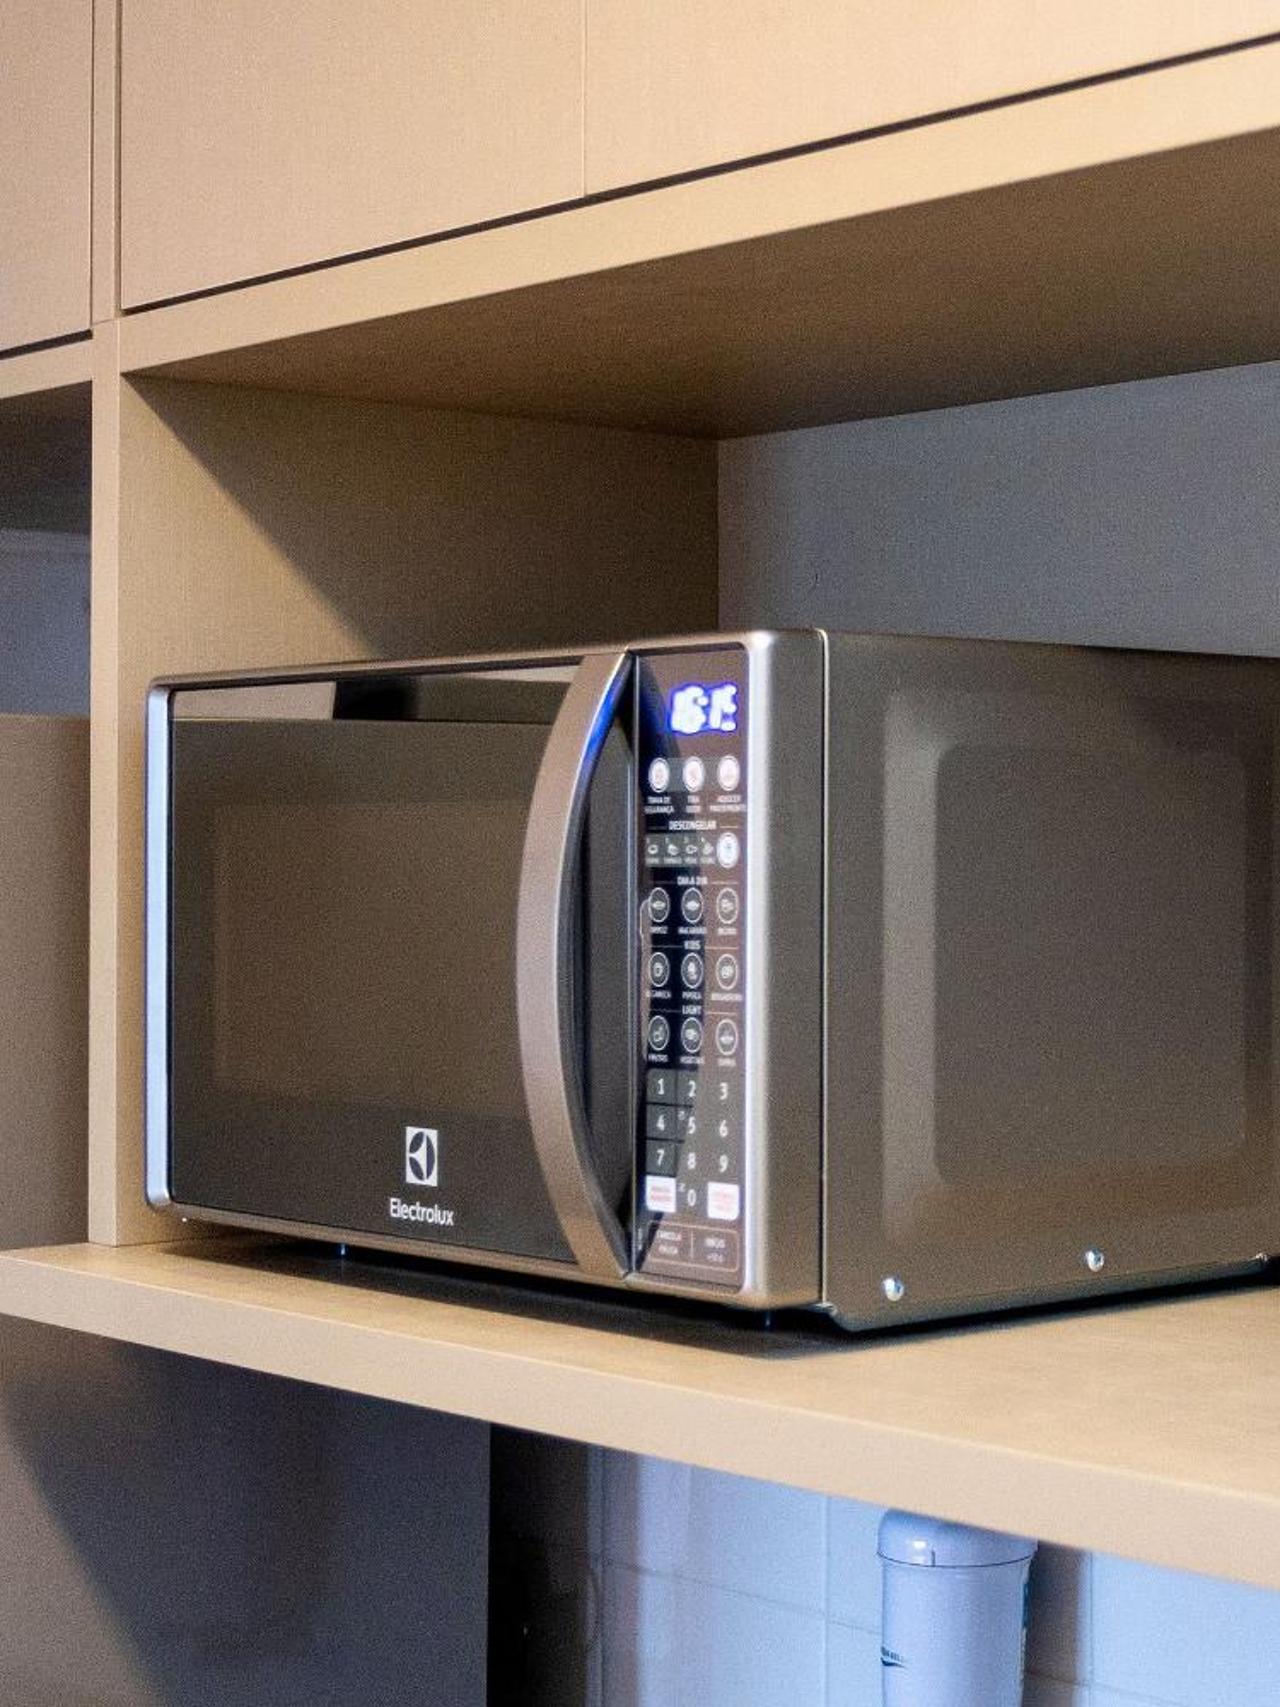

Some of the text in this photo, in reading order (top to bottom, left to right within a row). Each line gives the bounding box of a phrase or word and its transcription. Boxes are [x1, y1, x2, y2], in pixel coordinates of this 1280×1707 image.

[668, 820, 717, 830] DESCONGELAR
[682, 1005, 702, 1015] LIGHT
[657, 1078, 729, 1100] 1 2 3
[656, 1114, 729, 1138] 4 5 6
[656, 1148, 729, 1173] 7 8 9
[687, 1188, 697, 1207] 0
[390, 1197, 455, 1227] Electrolux
